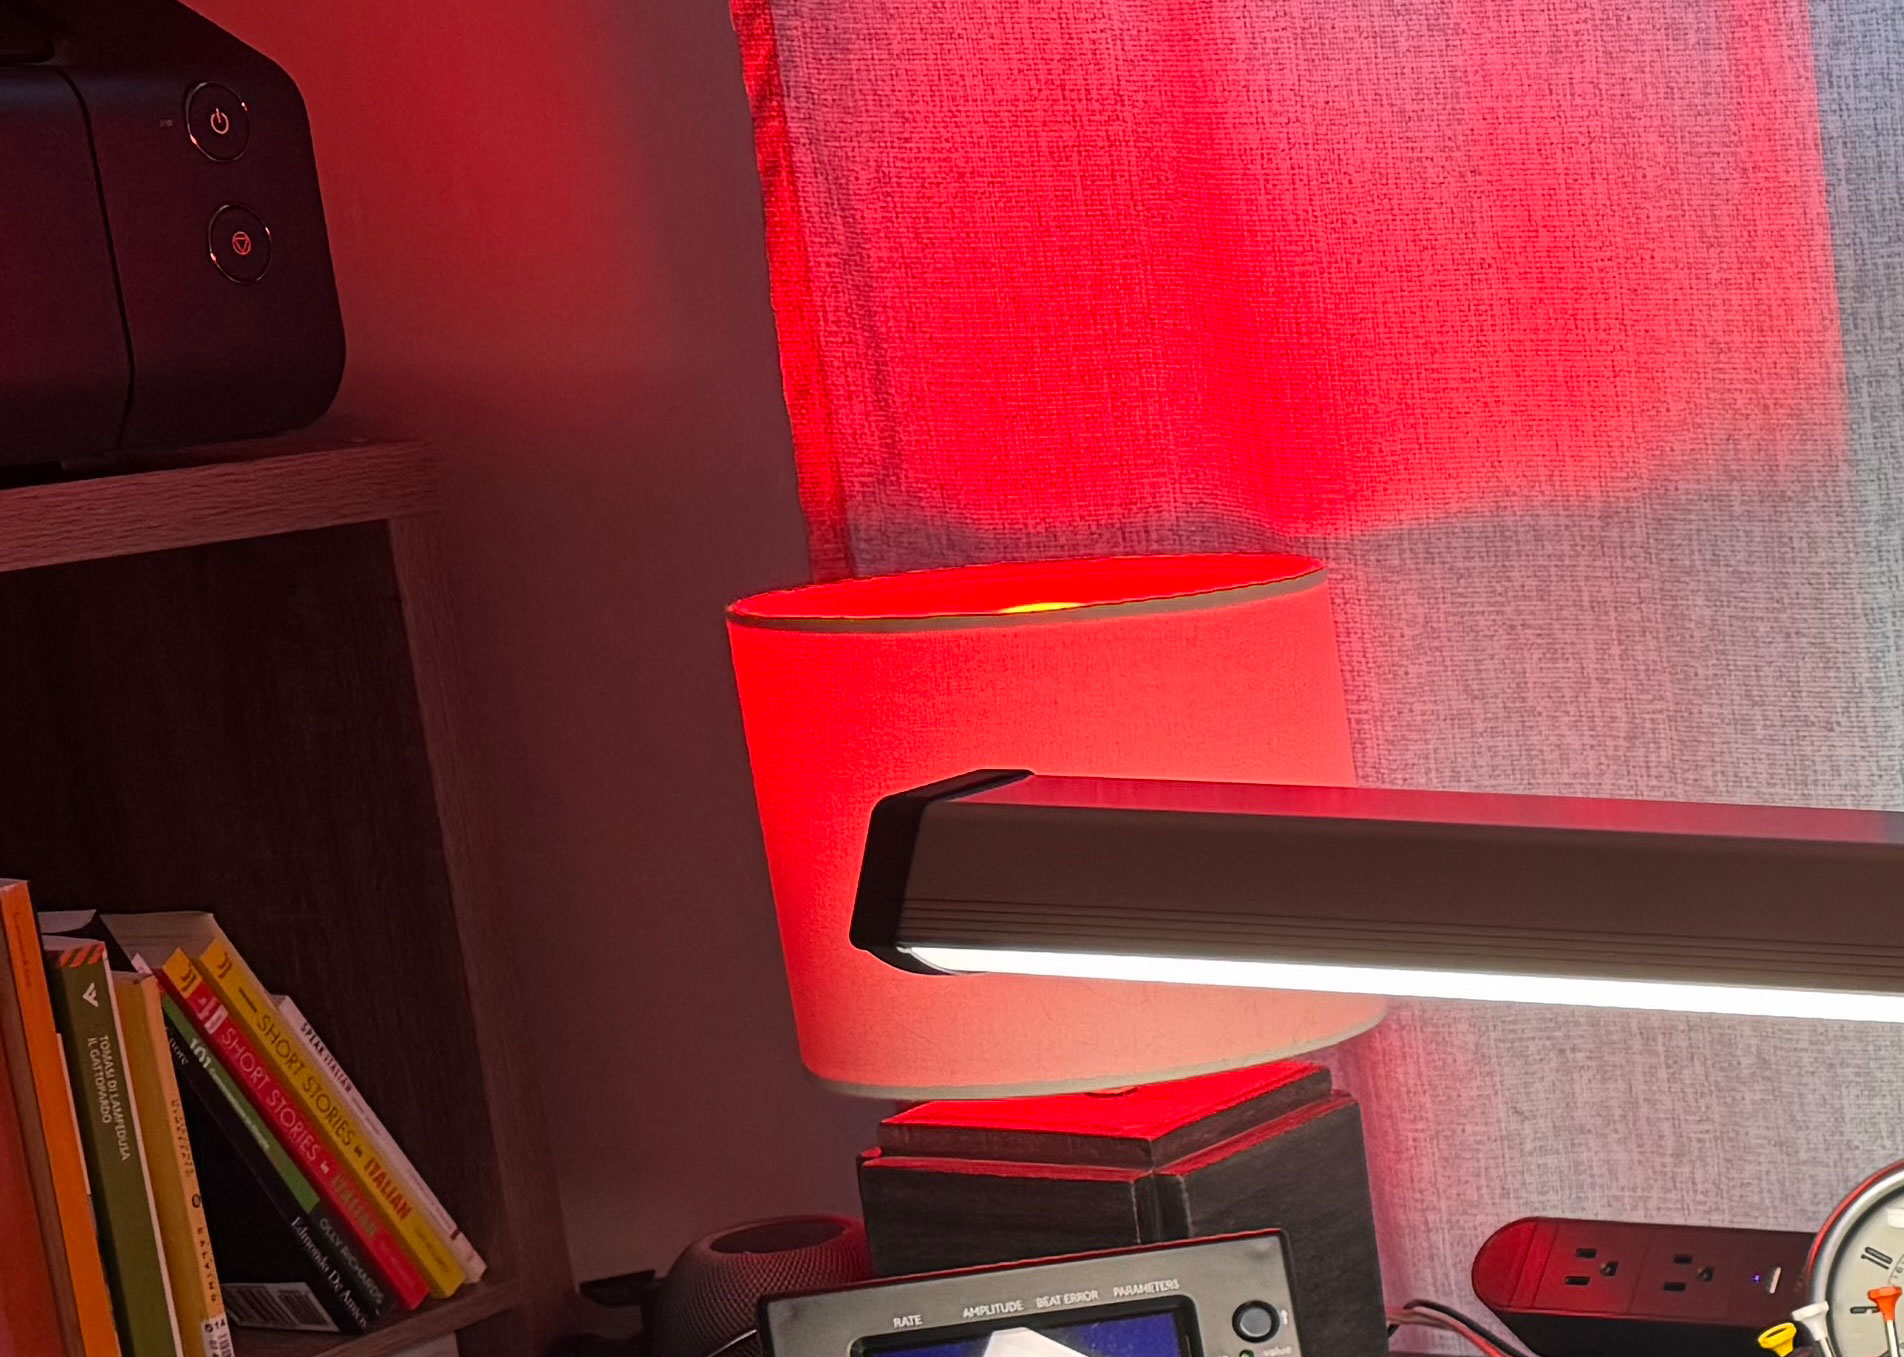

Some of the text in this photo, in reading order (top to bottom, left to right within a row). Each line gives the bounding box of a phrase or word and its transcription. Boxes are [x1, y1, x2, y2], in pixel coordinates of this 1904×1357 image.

[216, 1025, 274, 1091] SHORT
[262, 1087, 326, 1161] STORIES
[253, 1013, 309, 1077] SHORT
[298, 1075, 360, 1146] STORIES
[360, 1157, 415, 1220] ITALIAN
[1112, 1279, 1180, 1298] PARAMETERS
[1035, 1289, 1100, 1308] BEAT ERROR
[962, 1299, 1024, 1320] AMPLITUDE
[893, 1314, 923, 1328] RATE
[1263, 1344, 1292, 1357] value
